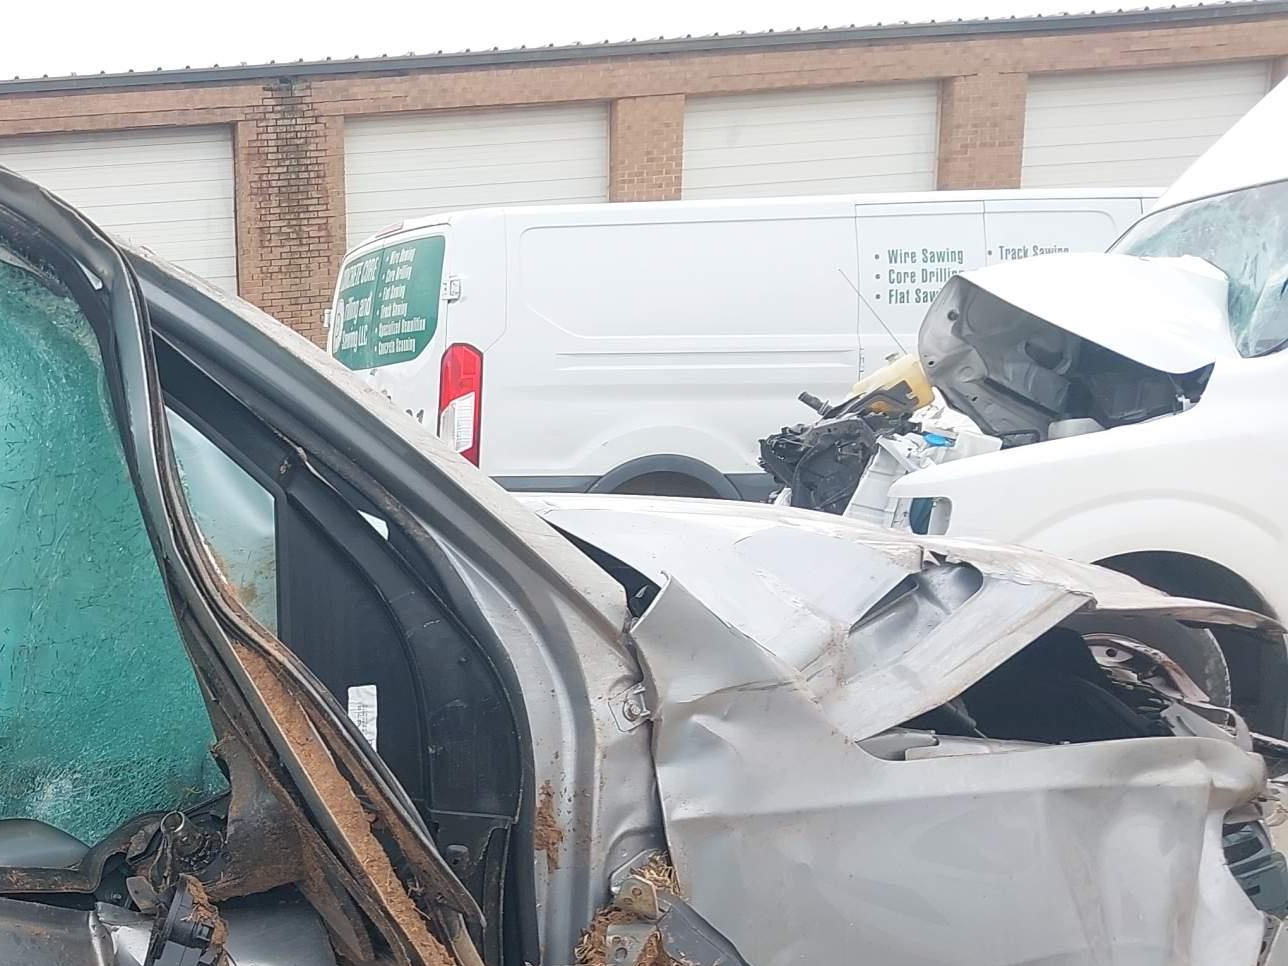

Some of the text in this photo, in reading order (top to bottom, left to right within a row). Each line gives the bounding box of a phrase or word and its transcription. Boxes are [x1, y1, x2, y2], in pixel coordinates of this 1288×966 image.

[888, 247, 964, 264] Wire Sawing
[998, 245, 1029, 260] Track
[888, 267, 964, 284] Core Drilli
[359, 291, 373, 317] and
[888, 288, 939, 304] Flat Saw
[358, 324, 369, 347] LLC
